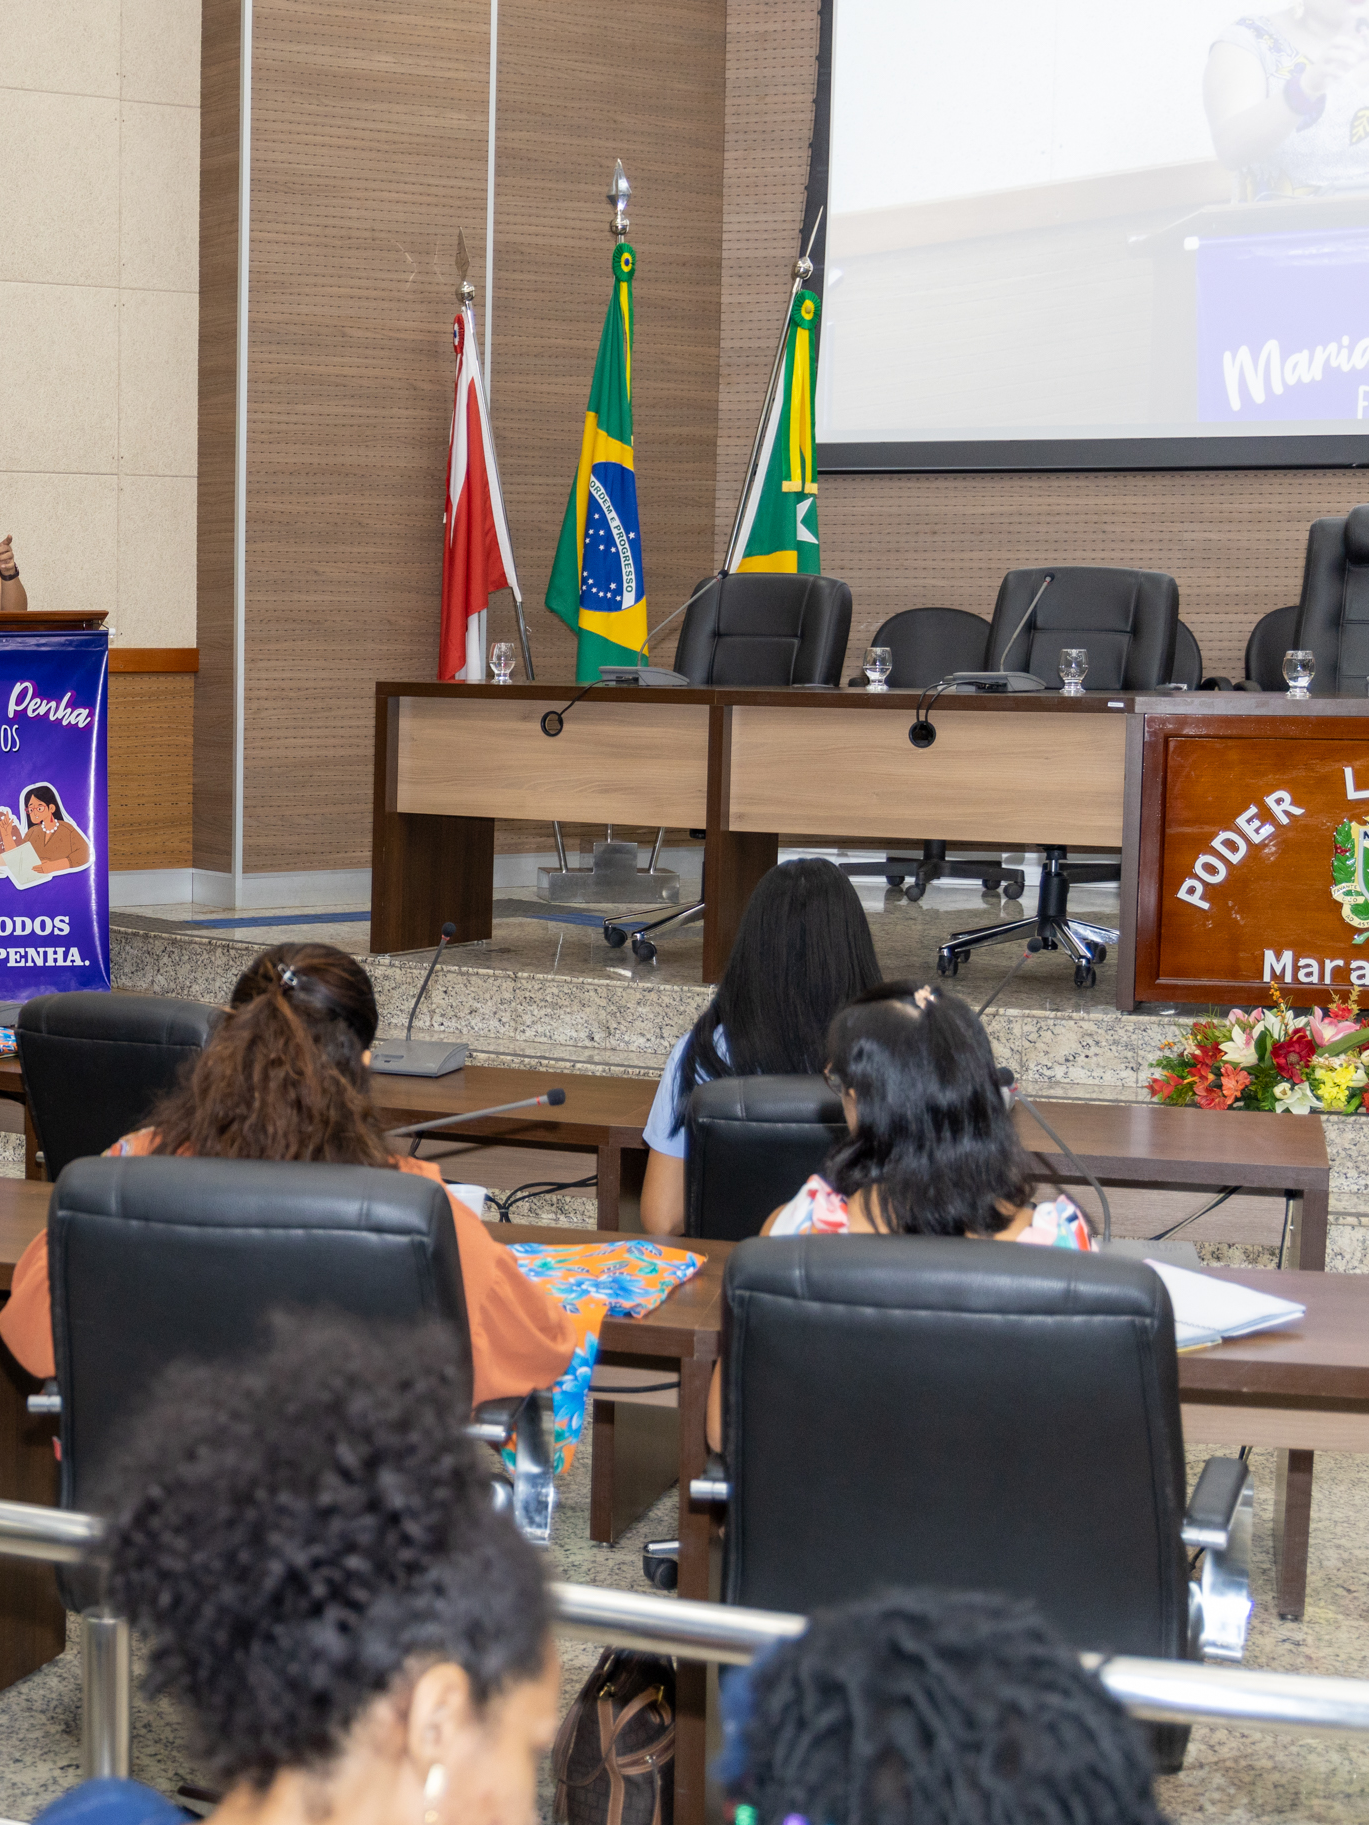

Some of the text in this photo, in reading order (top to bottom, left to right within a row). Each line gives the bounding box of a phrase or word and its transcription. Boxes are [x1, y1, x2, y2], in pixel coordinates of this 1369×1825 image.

[589, 480, 613, 515] ORDEM
[613, 525, 634, 593] PROGRESSO
[7, 682, 92, 728] Penha
[1176, 789, 1306, 910] PODER
[1262, 949, 1369, 985] Mara
